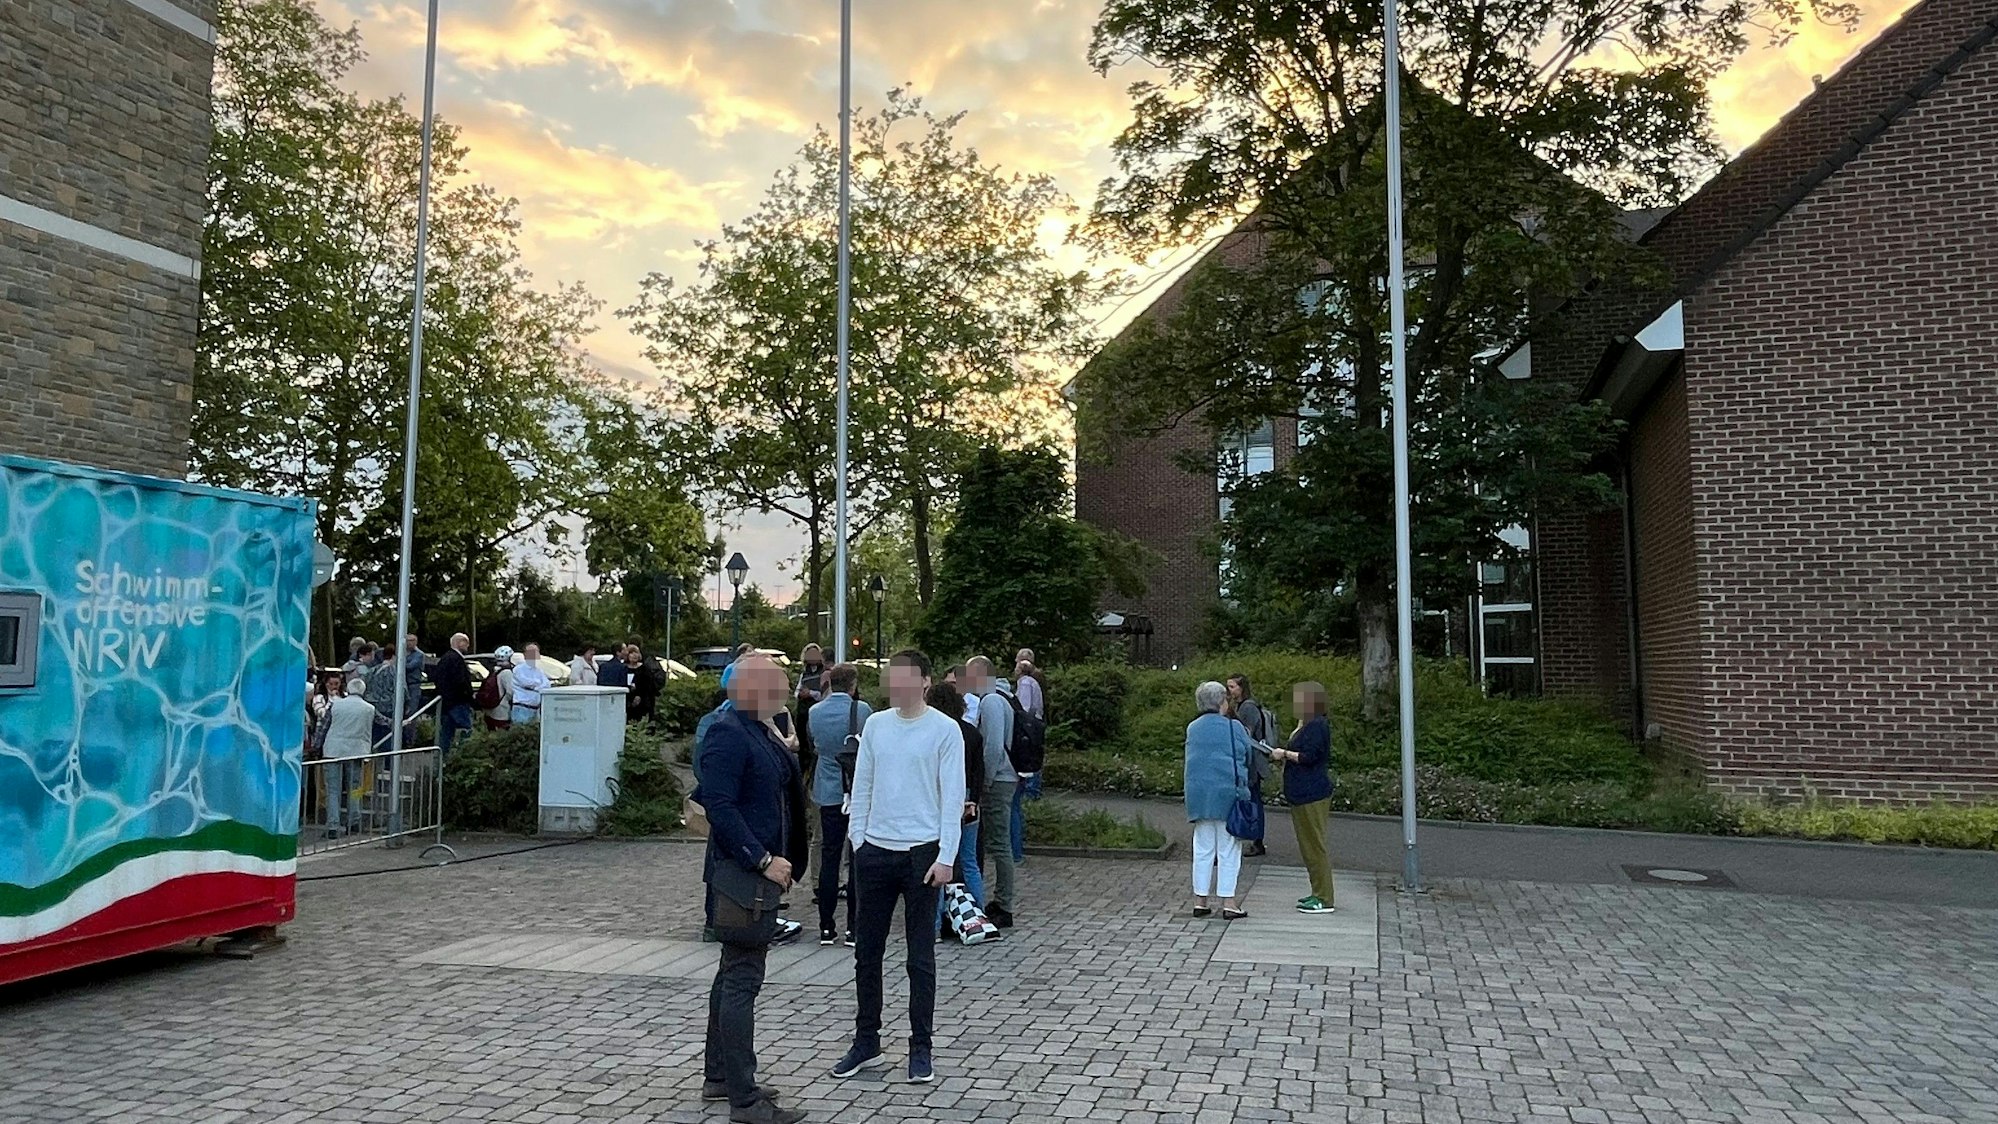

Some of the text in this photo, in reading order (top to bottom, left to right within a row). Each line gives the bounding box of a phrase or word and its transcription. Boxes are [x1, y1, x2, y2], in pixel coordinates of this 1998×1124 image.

[76, 559, 223, 598] Schwimm-
[76, 595, 205, 628] offensive
[74, 628, 166, 672] NRW
